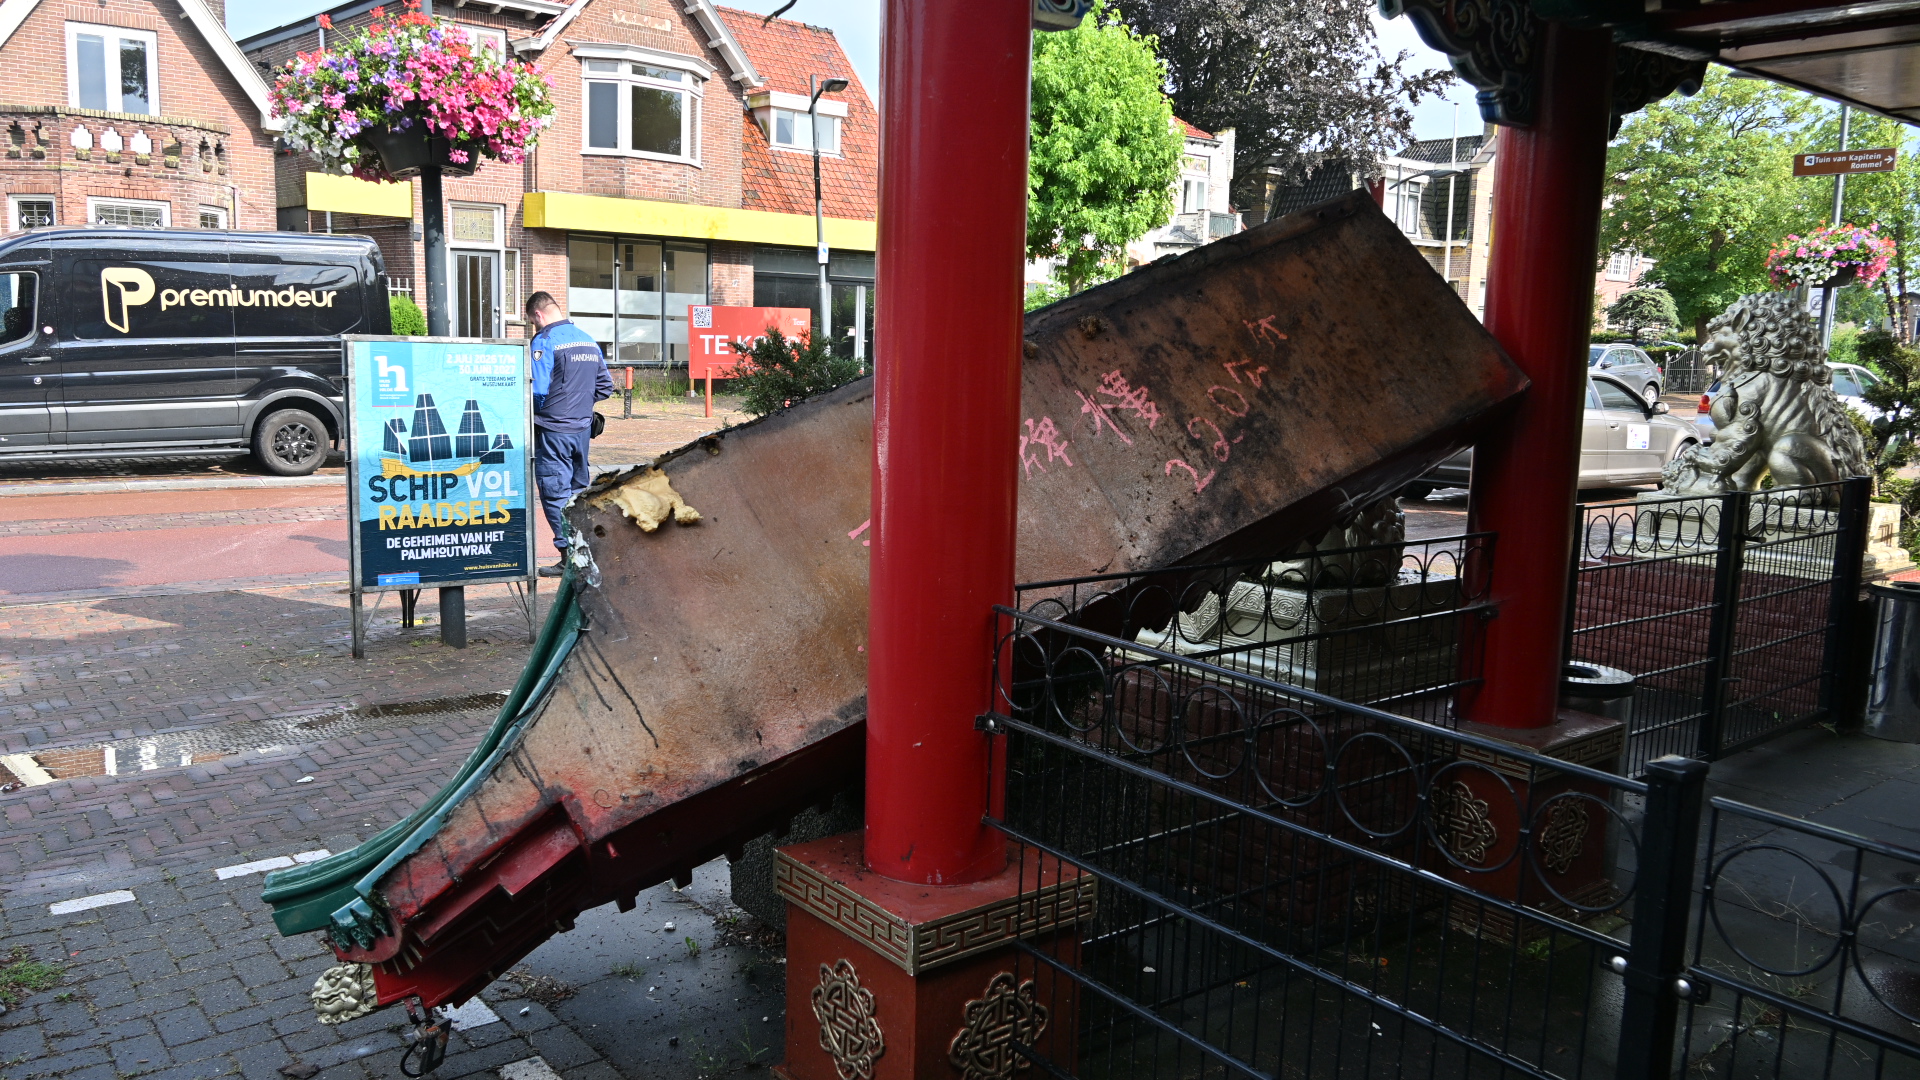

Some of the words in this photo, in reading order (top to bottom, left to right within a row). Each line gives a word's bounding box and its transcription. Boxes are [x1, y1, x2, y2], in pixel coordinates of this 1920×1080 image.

[1848, 153, 1882, 162] Kapitein
[1850, 161, 1882, 169] Rommel
[160, 284, 338, 311] premiumdeur
[699, 334, 730, 355] TE
[446, 354, 453, 364] 2
[454, 354, 473, 364] JULI
[474, 354, 497, 364] 2026
[498, 354, 516, 365] T/M
[459, 365, 471, 375] 30
[471, 365, 492, 375] JUNI
[493, 365, 516, 375] 2027
[368, 473, 459, 503] SCHIP
[466, 470, 518, 498] VOL
[378, 499, 511, 530] RAADSELS
[386, 537, 401, 549] DE
[402, 533, 459, 548] GEHEIMEN
[460, 532, 482, 544] VAN
[484, 531, 505, 542] HET
[401, 544, 492, 561] PALMHOUTWRAK
